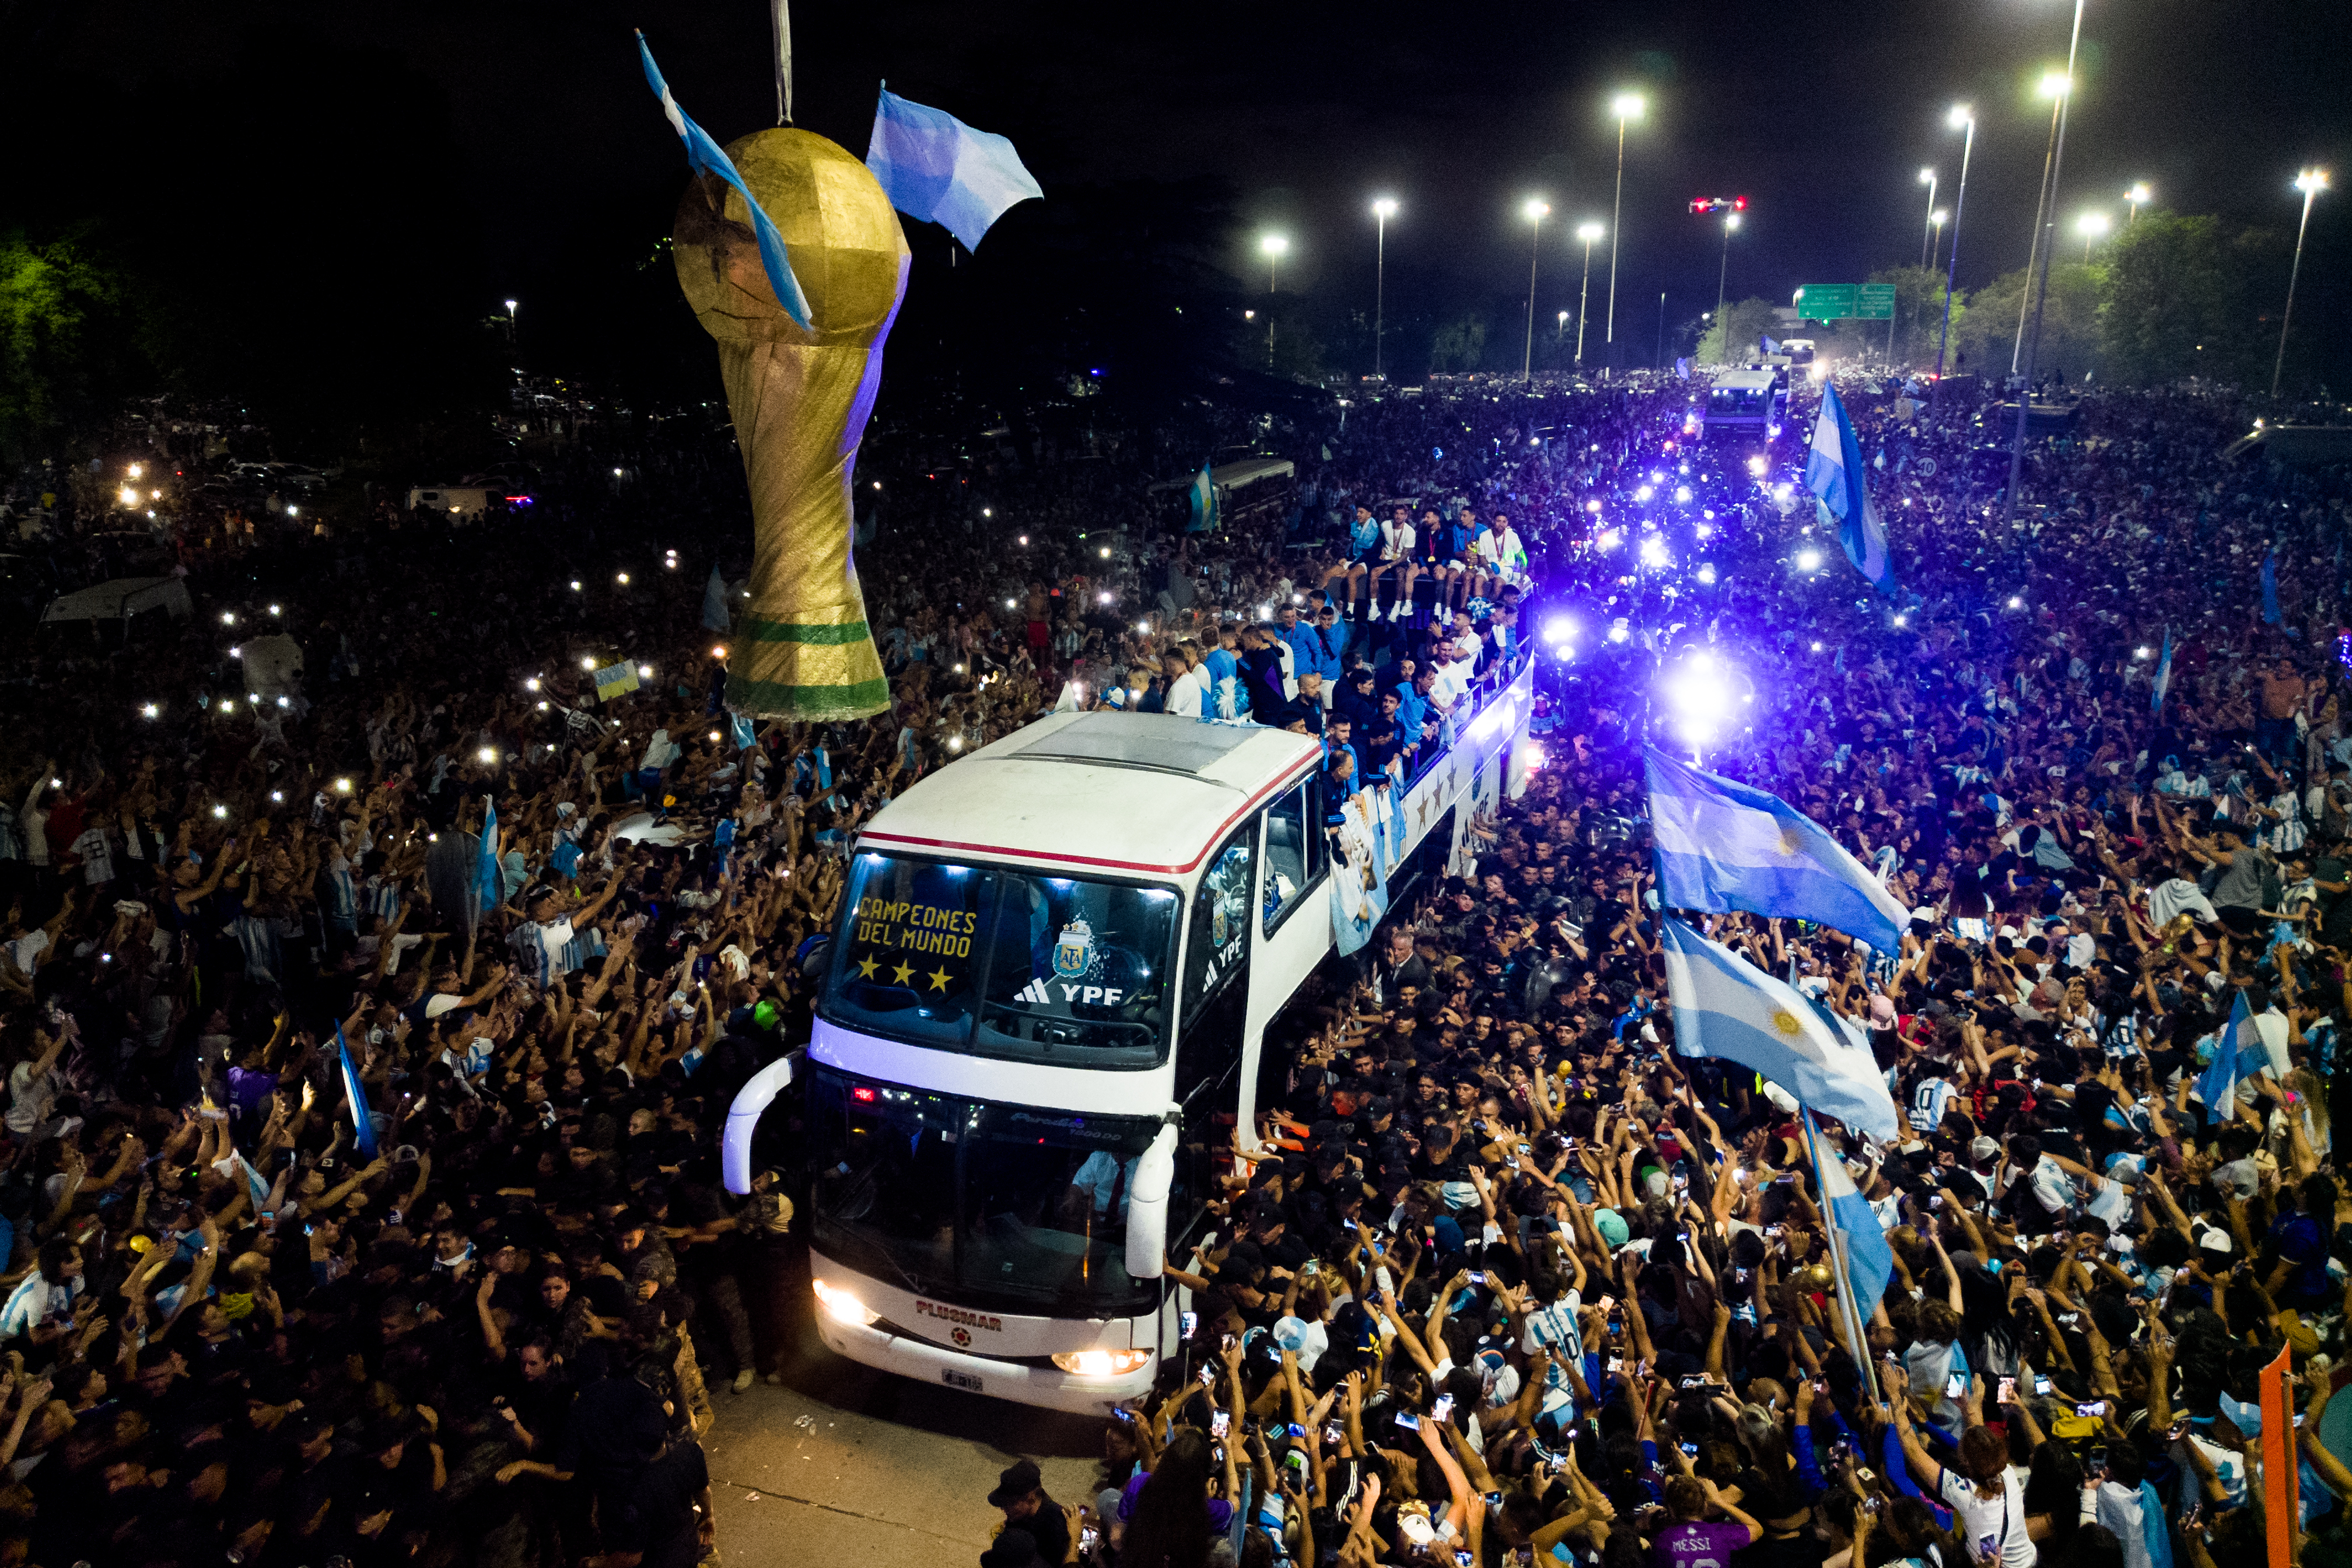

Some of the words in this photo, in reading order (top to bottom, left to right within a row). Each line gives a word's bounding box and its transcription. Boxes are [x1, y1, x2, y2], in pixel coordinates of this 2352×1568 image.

[859, 897, 977, 933] CAMPEONES
[858, 921, 892, 946] DEL
[901, 928, 971, 957] MUNDO
[1219, 933, 1242, 968] YPF
[1060, 984, 1122, 1006] YPF
[1918, 1088, 1934, 1110] 0
[916, 1300, 1002, 1332] PLUSMAR
[1559, 1332, 1579, 1360] 0
[1672, 1537, 1712, 1553] MESSI
